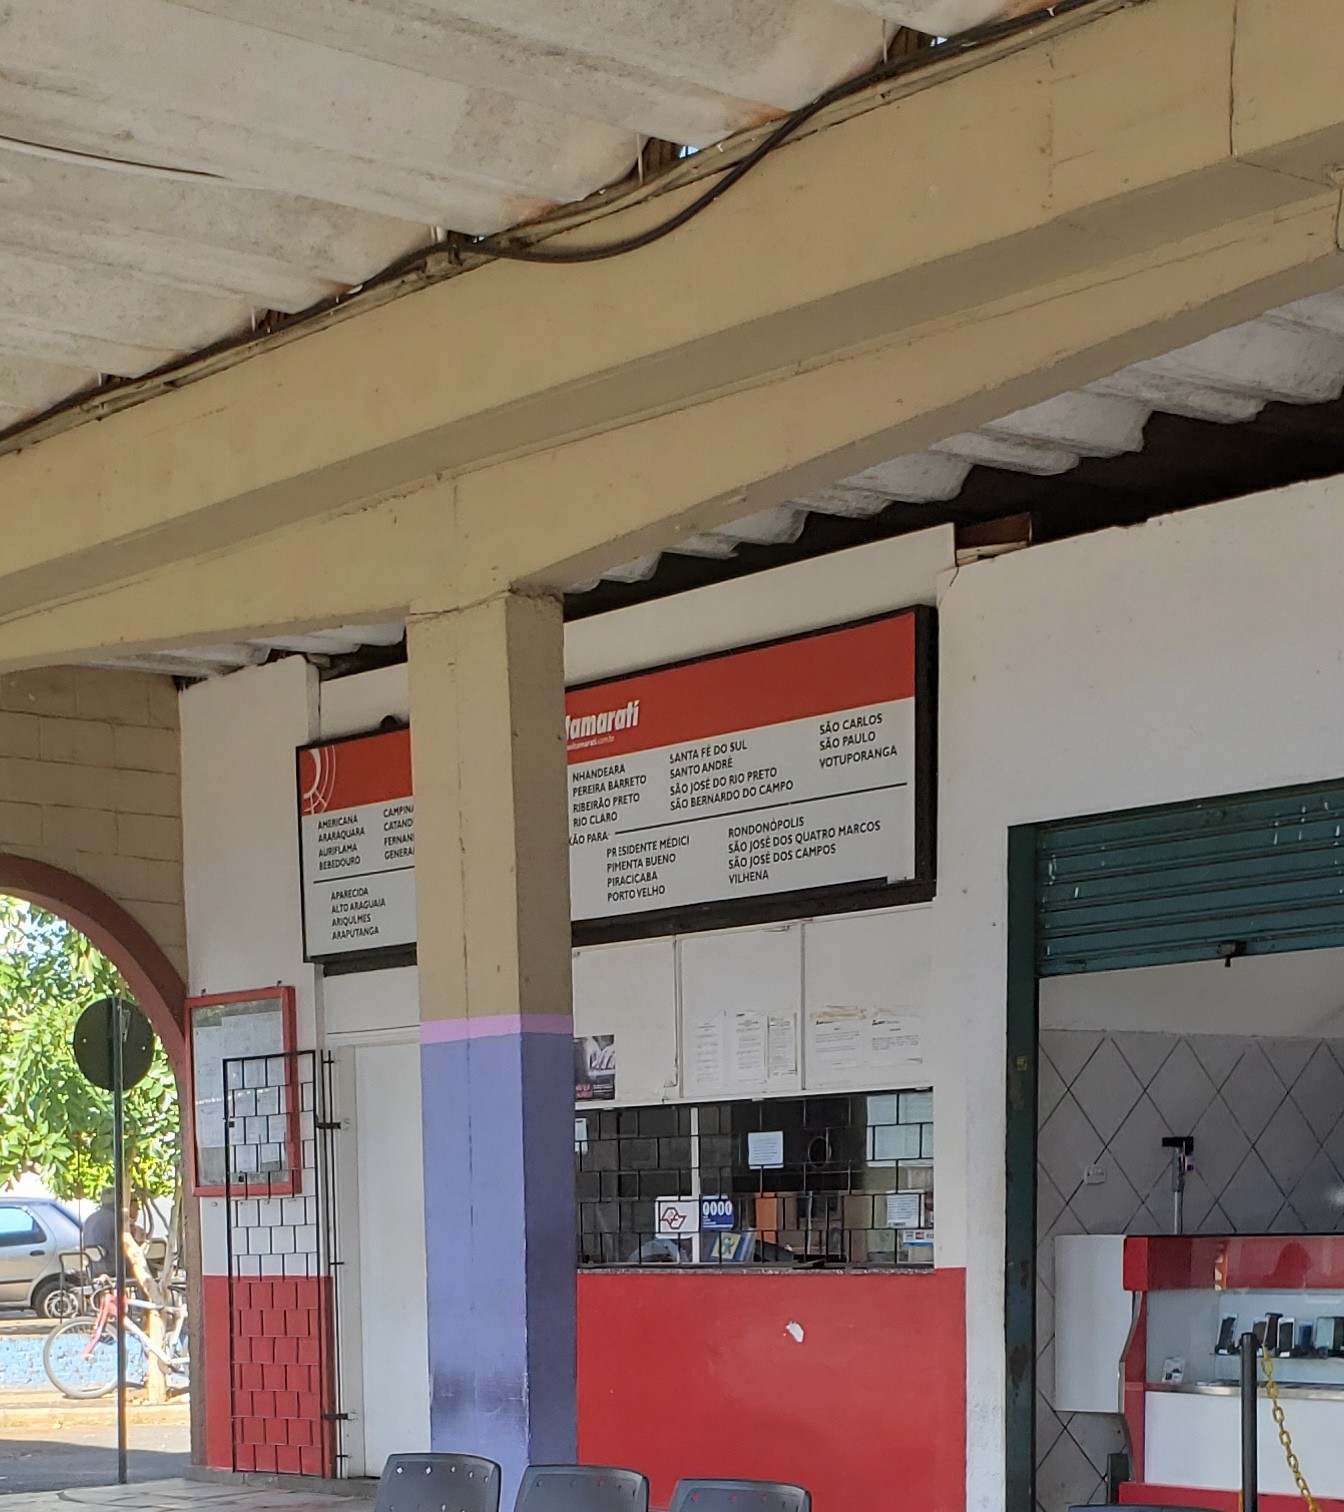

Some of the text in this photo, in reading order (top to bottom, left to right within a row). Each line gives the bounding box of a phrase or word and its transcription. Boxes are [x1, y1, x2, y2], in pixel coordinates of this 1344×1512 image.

[819, 713, 883, 735] SÃO CARLOS
[819, 731, 876, 751] SÃO PAULO
[669, 739, 747, 764] SANTA FÉ DO SUL
[819, 745, 898, 768] VOTUPORANGA
[573, 764, 626, 782] NHANDEARA
[670, 756, 733, 779] SANTO ANDRÉ
[573, 775, 647, 797] PEREIRA BARRETO
[670, 767, 777, 796] SÃO JOSÉ DO RIO PRETO
[573, 793, 640, 813] RIBEIRÃO PRETO
[670, 780, 794, 811] SÃO BERNARDO DO CAMPO
[318, 814, 358, 830] AMERICANA
[573, 812, 618, 827] RIO CLARO
[728, 816, 804, 838] RONDONÓPOLIS
[318, 827, 365, 843] ARARAQUARA
[384, 833, 414, 846] FERNAN
[728, 820, 881, 853] SÃO JOSÉ DOS QUATRO MARCOS
[318, 843, 358, 858] AURIFLAMA
[384, 847, 415, 860] GENERA
[606, 835, 690, 858] PRESIDENTE MÉDICI
[319, 856, 360, 871] BEBEDOURO
[607, 853, 676, 873] PIMENTA BUENO
[728, 843, 836, 870] SÃO JOSÉ DOS CAMPOS
[607, 871, 658, 888] PIRACICABA
[729, 869, 769, 884] VILHENA
[331, 887, 369, 901] APARECIDA
[607, 885, 666, 902] PORTO VELHO
[331, 898, 386, 914] ALTO ARAGUAIA
[332, 926, 379, 940] ARAPUTANGA
